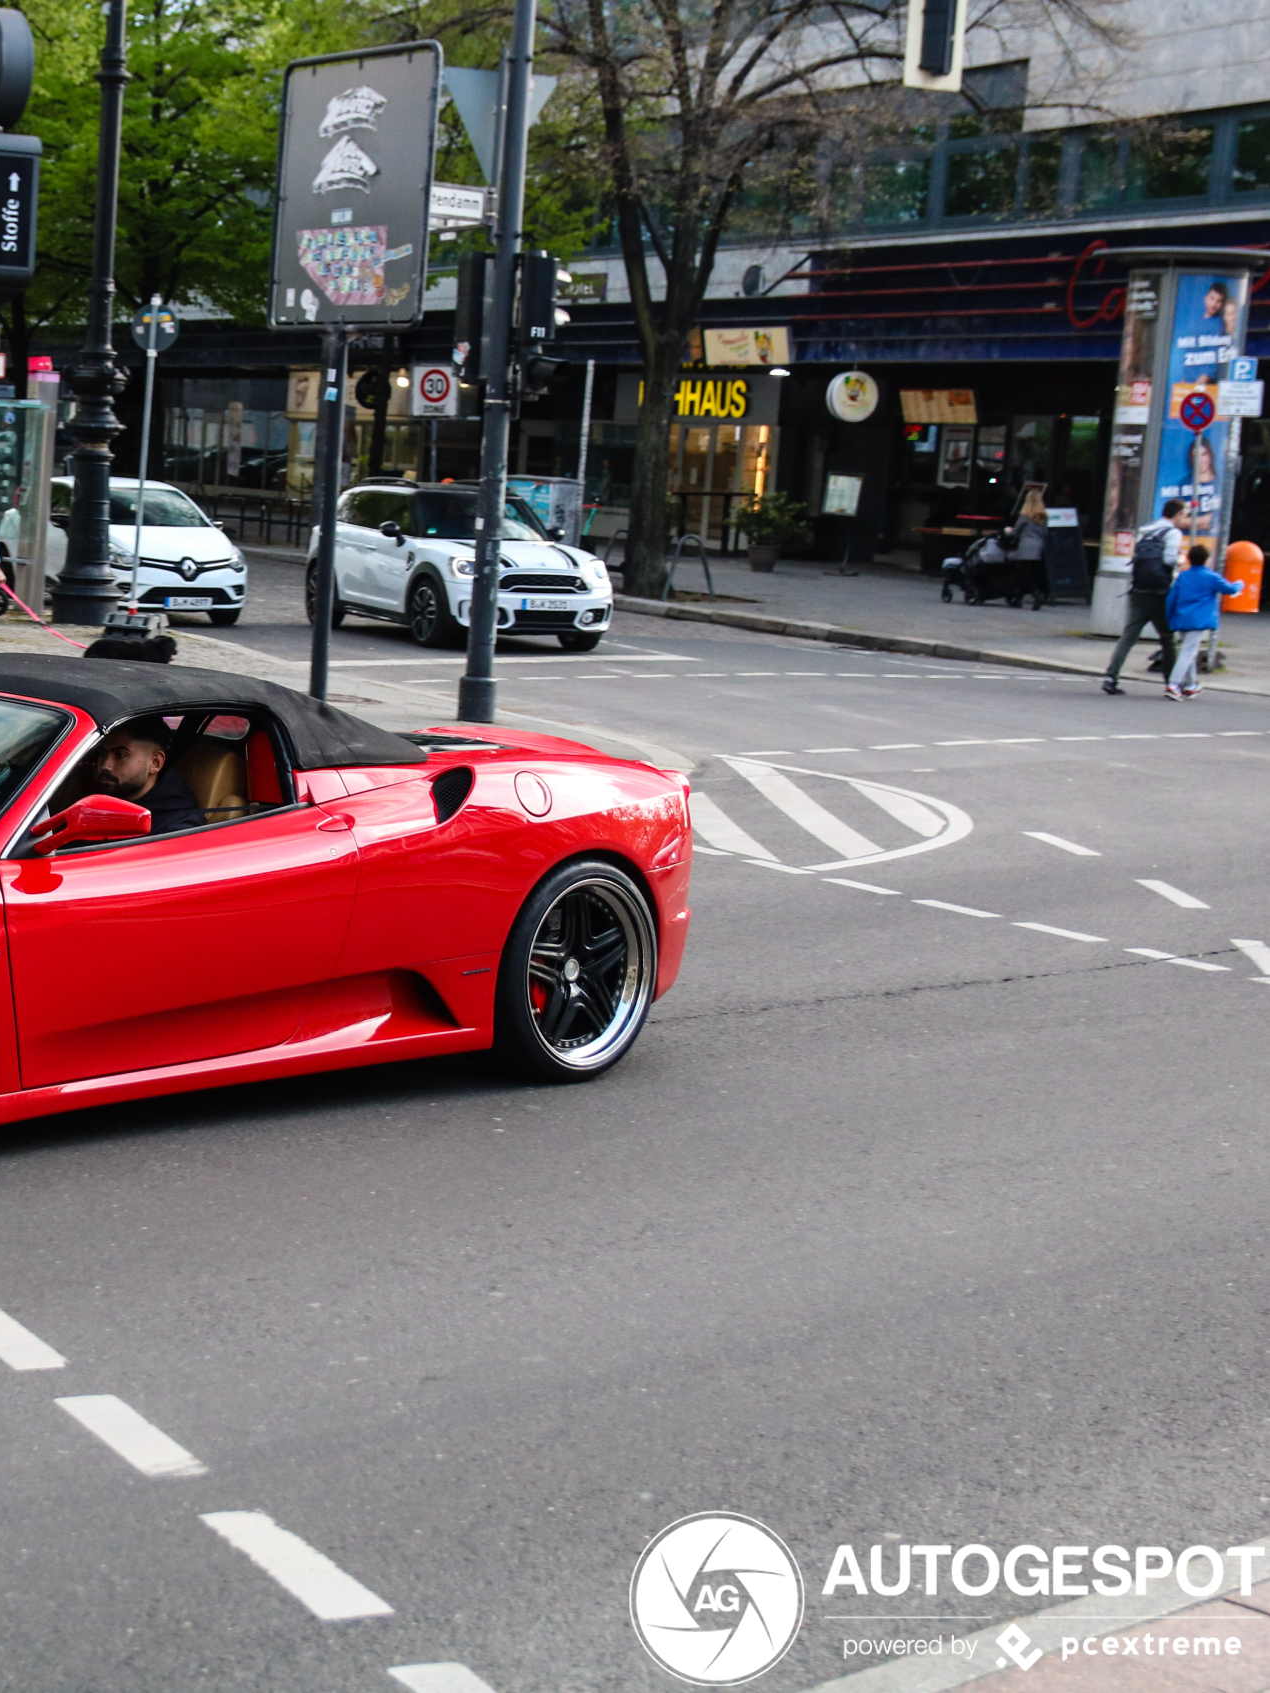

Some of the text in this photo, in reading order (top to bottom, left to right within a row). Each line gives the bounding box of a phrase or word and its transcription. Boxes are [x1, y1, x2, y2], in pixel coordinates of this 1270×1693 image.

[432, 192, 479, 210] tendamm
[1, 198, 20, 252] Stoffe
[1183, 350, 1216, 366] zum
[426, 378, 444, 394] 30
[423, 404, 446, 414] ZONE
